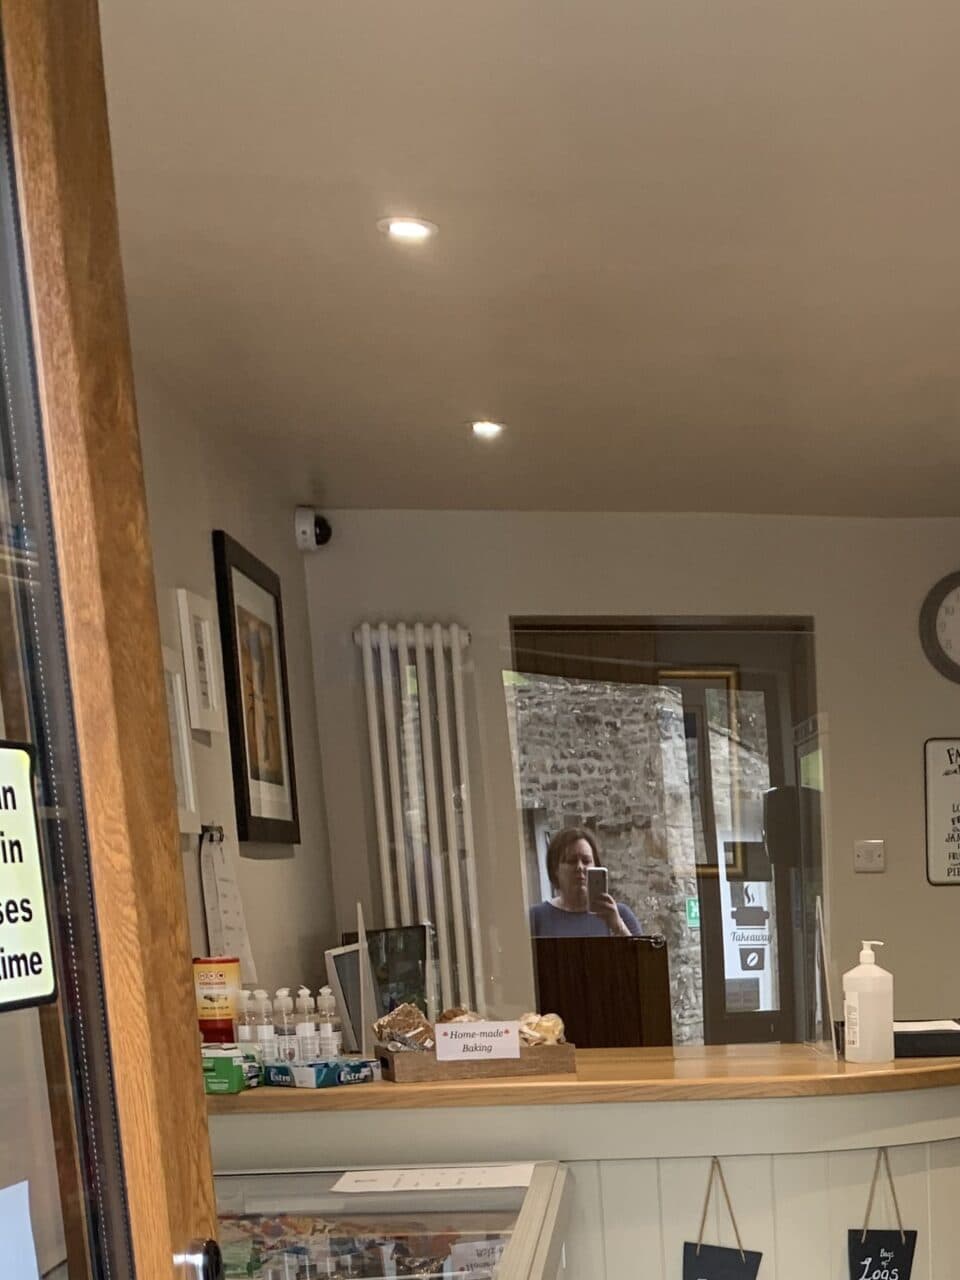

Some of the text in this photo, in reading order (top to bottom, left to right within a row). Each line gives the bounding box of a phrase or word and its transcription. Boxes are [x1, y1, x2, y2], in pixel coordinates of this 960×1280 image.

[0, 947, 43, 981] ime
[449, 1028, 504, 1041] Home-made
[462, 1042, 493, 1055] Baking
[340, 1068, 369, 1083] Extra
